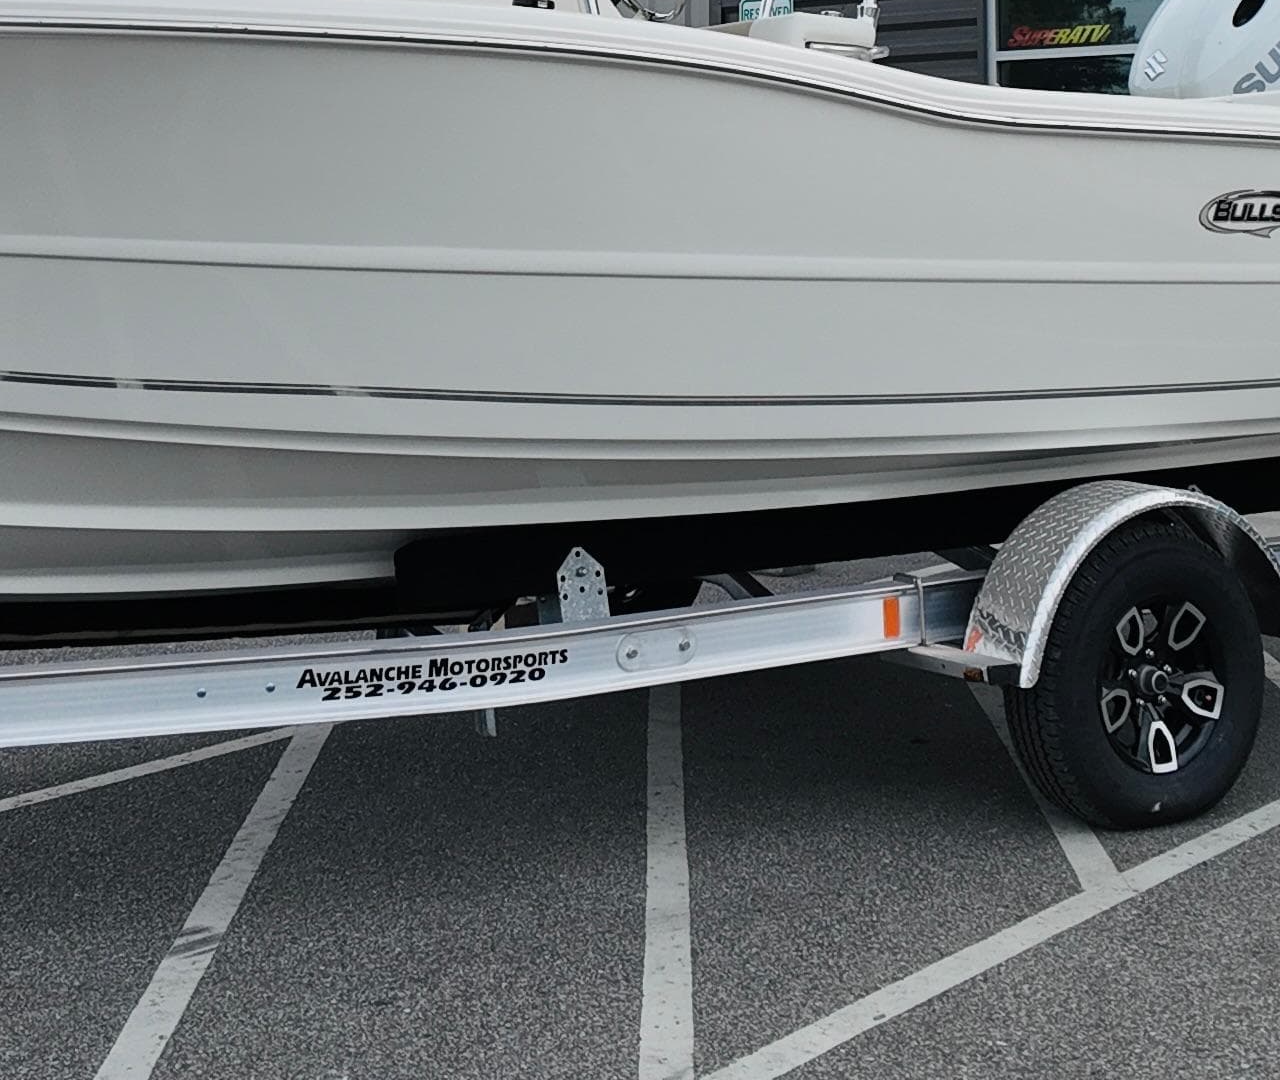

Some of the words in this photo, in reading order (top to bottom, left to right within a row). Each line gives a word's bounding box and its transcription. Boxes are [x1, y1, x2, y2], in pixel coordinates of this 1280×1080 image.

[743, 6, 790, 20] RESVED
[296, 664, 423, 689] AVALANCHE
[427, 648, 568, 678] MOTORSPORTS
[321, 667, 546, 702] 252-946-0920
